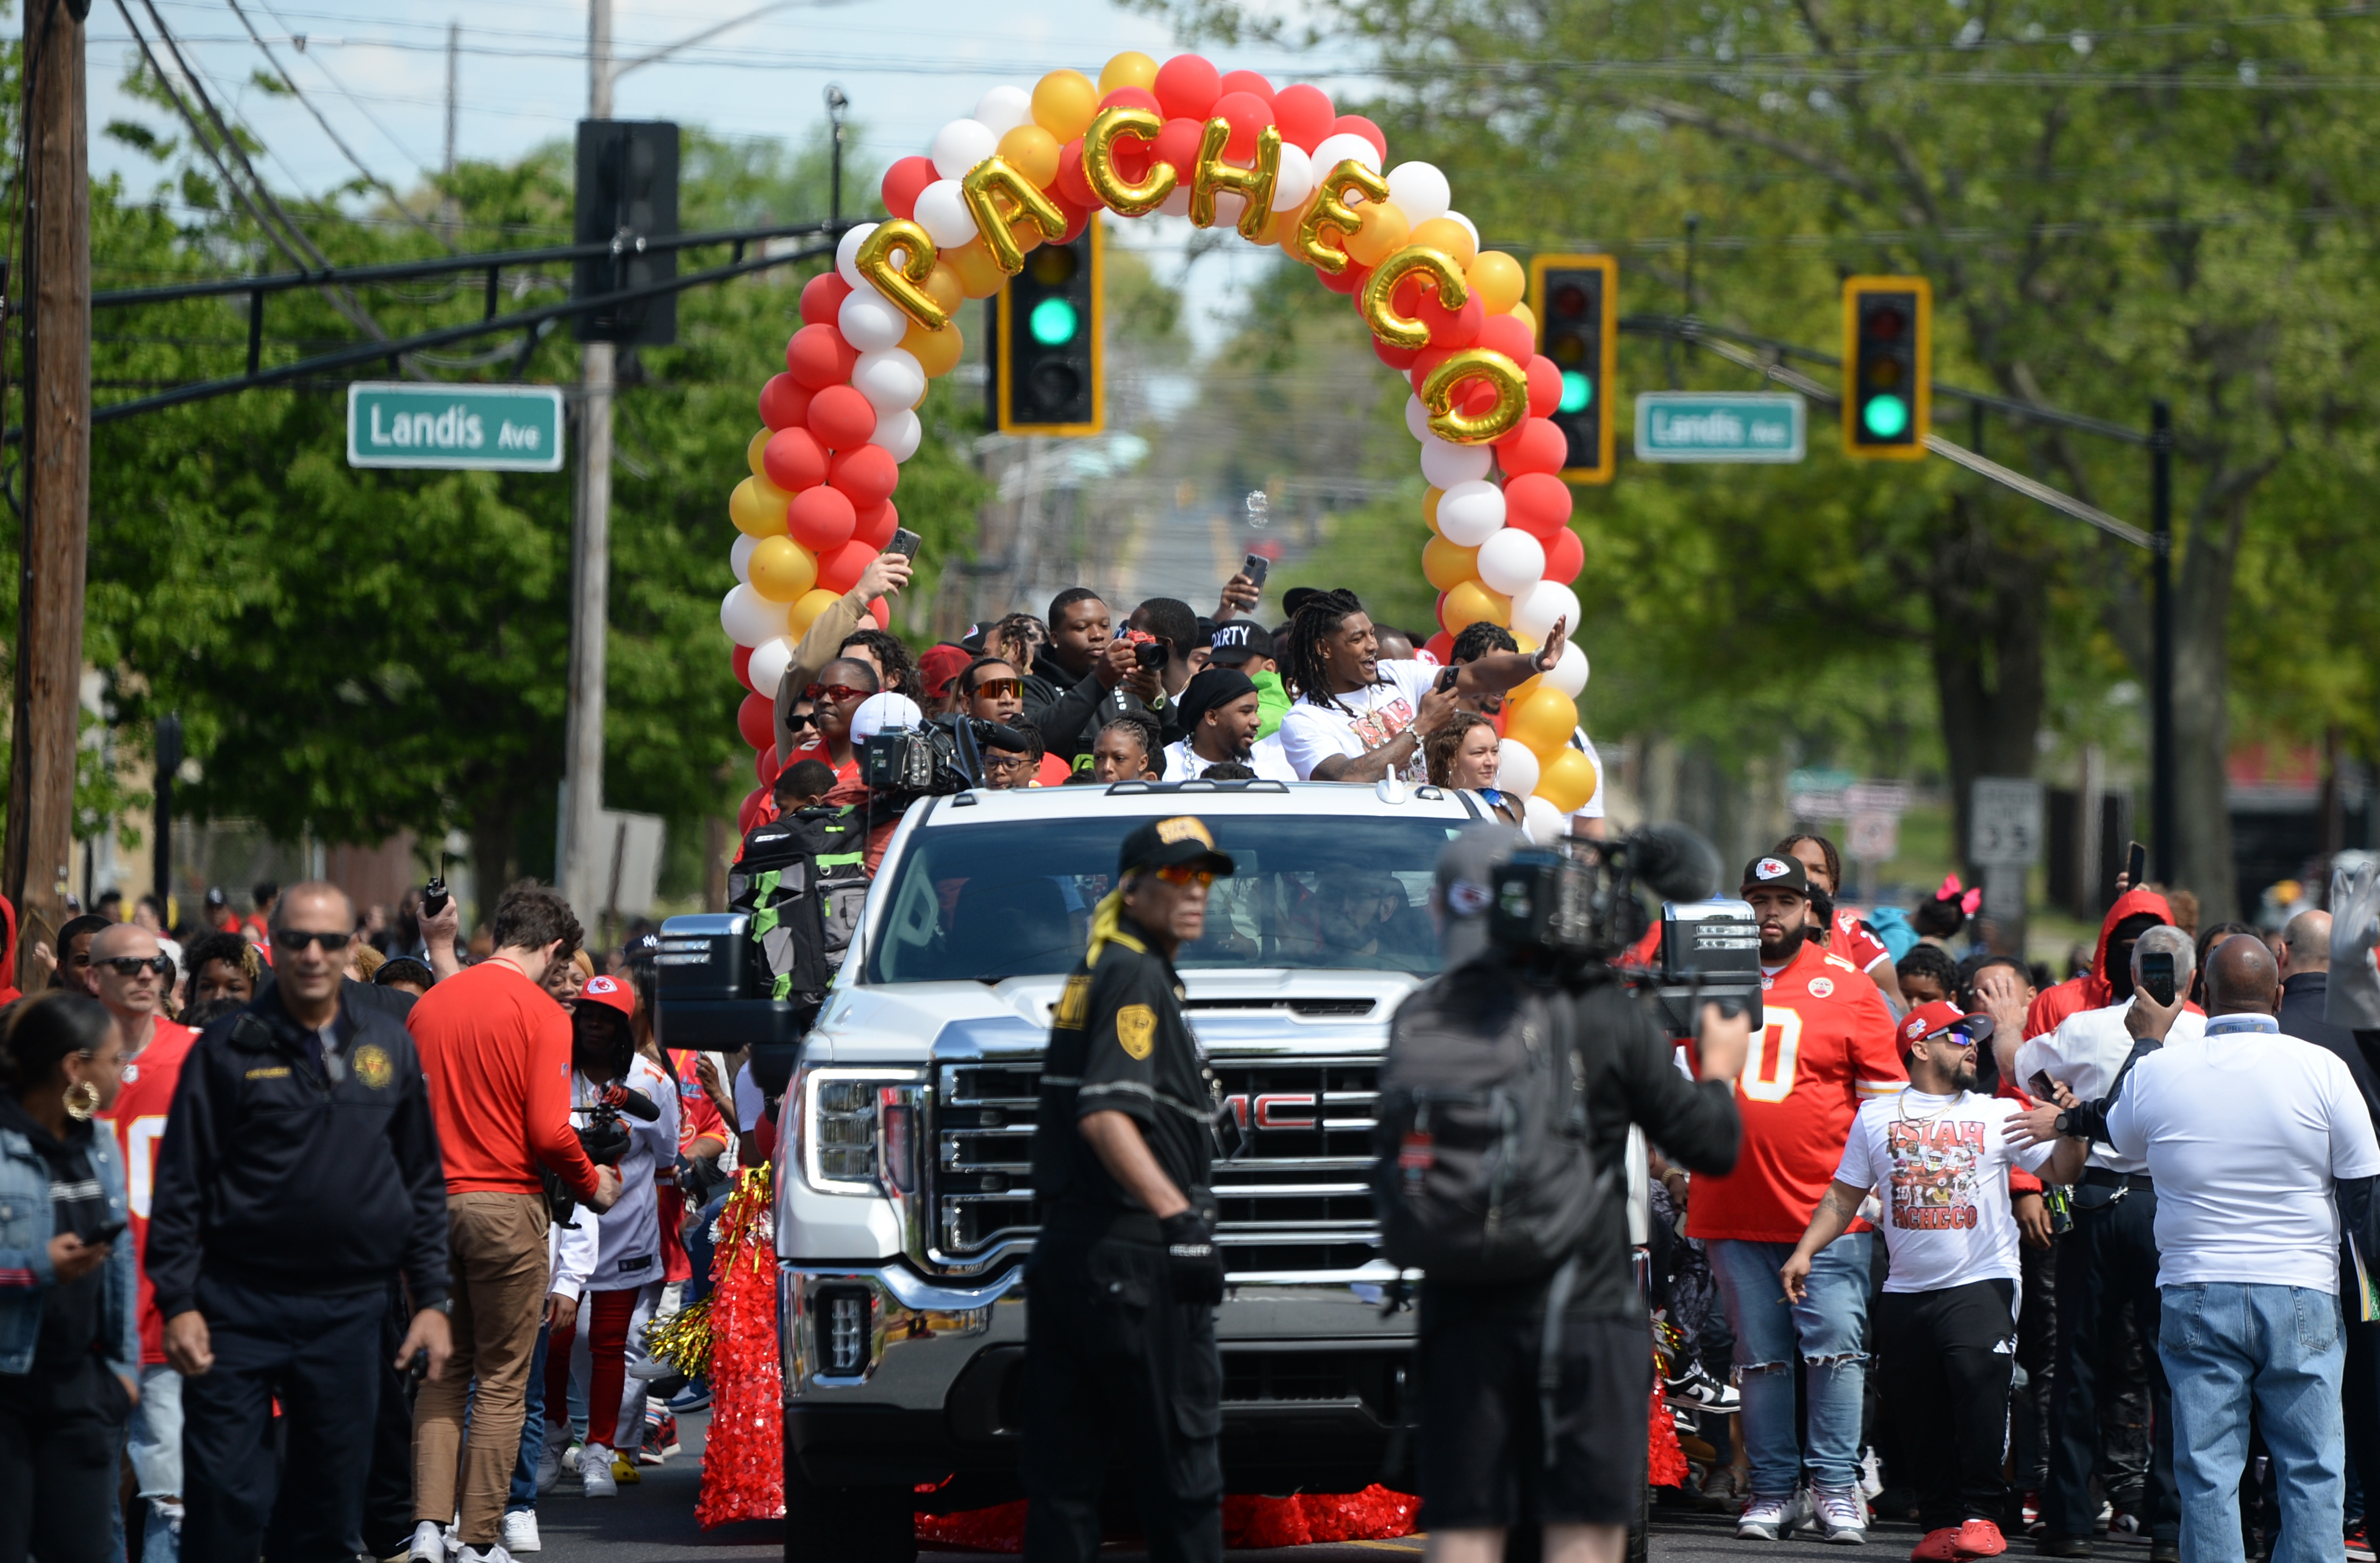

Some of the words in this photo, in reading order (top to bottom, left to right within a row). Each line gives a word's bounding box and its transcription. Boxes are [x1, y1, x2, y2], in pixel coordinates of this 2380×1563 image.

[856, 106, 1528, 446] PACHECO
[370, 402, 484, 450] Landis
[497, 419, 542, 451] Ave
[1651, 407, 1745, 447] Landis
[1887, 1120, 1985, 1155] ISIAH
[1892, 1205, 1978, 1231] PACHECO
